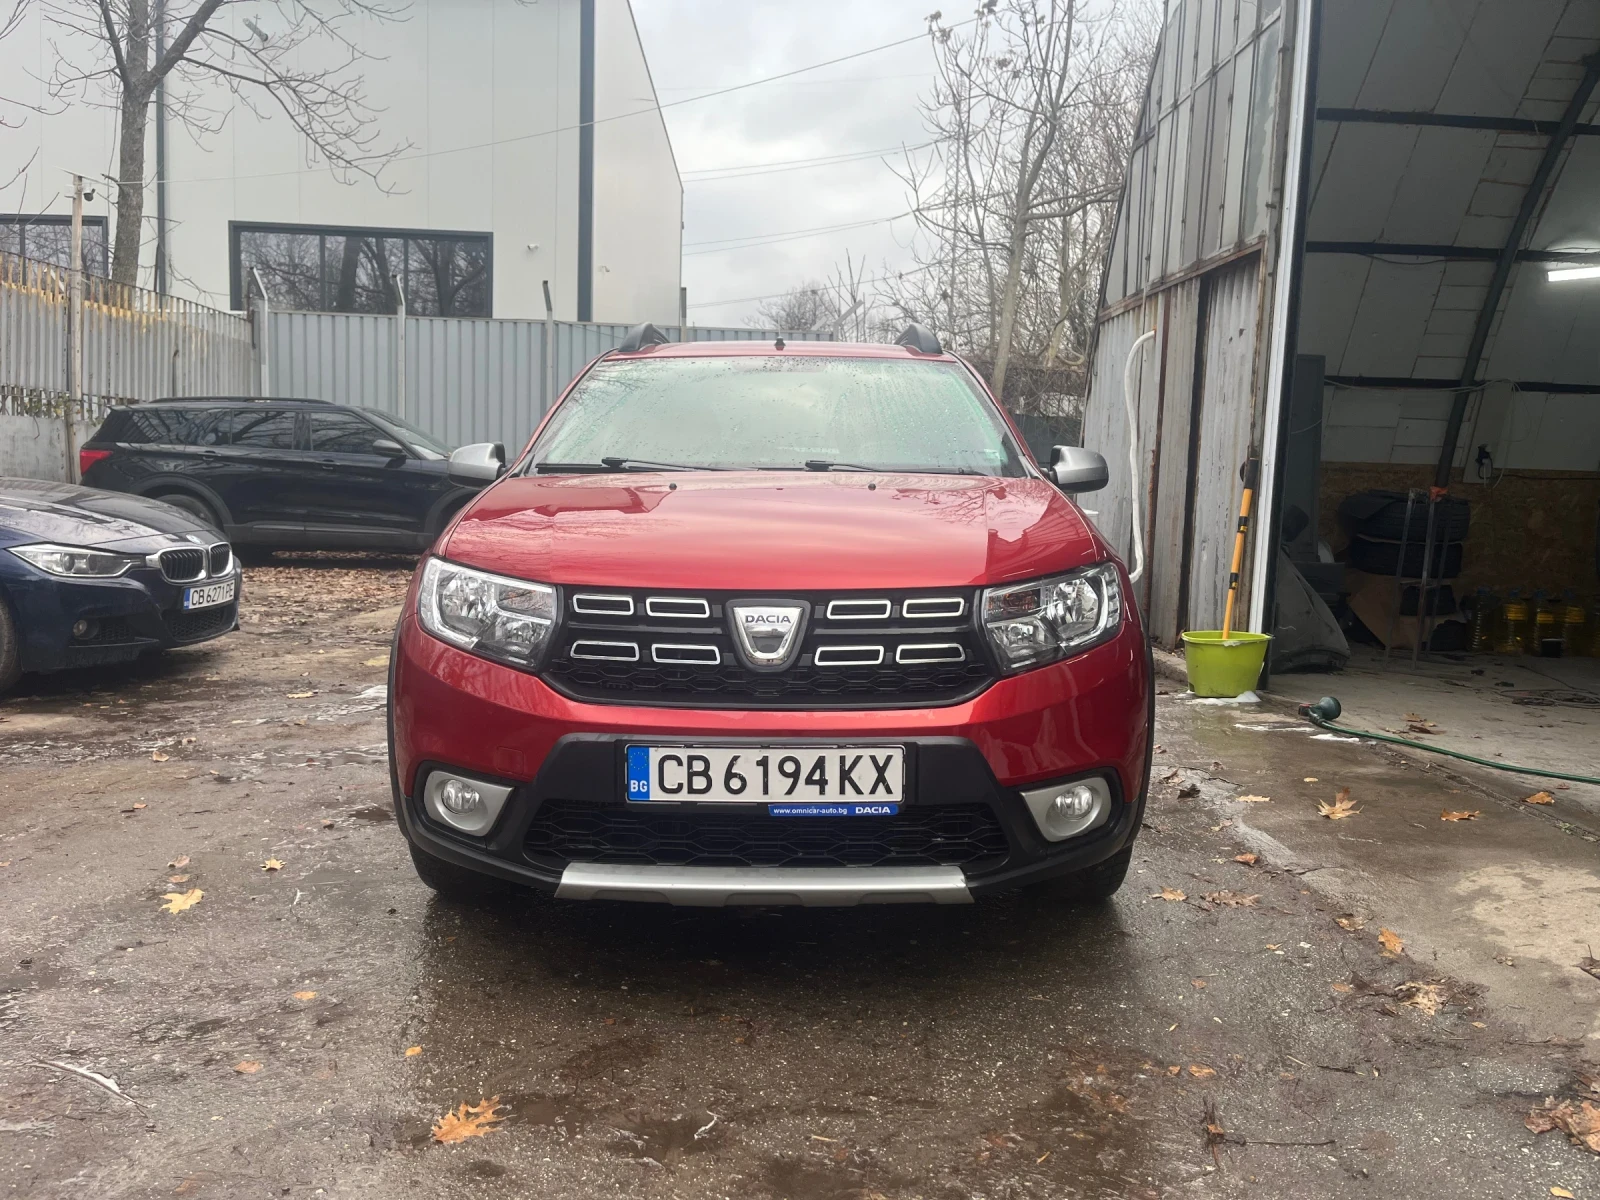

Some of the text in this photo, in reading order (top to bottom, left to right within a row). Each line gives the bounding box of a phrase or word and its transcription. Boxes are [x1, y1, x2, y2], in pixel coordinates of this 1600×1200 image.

[745, 615, 791, 624] DACIA
[657, 754, 894, 796] CB 6194 KX
[630, 780, 648, 792] BG
[773, 806, 891, 816] www.omnicar-auto.bg DACIA
